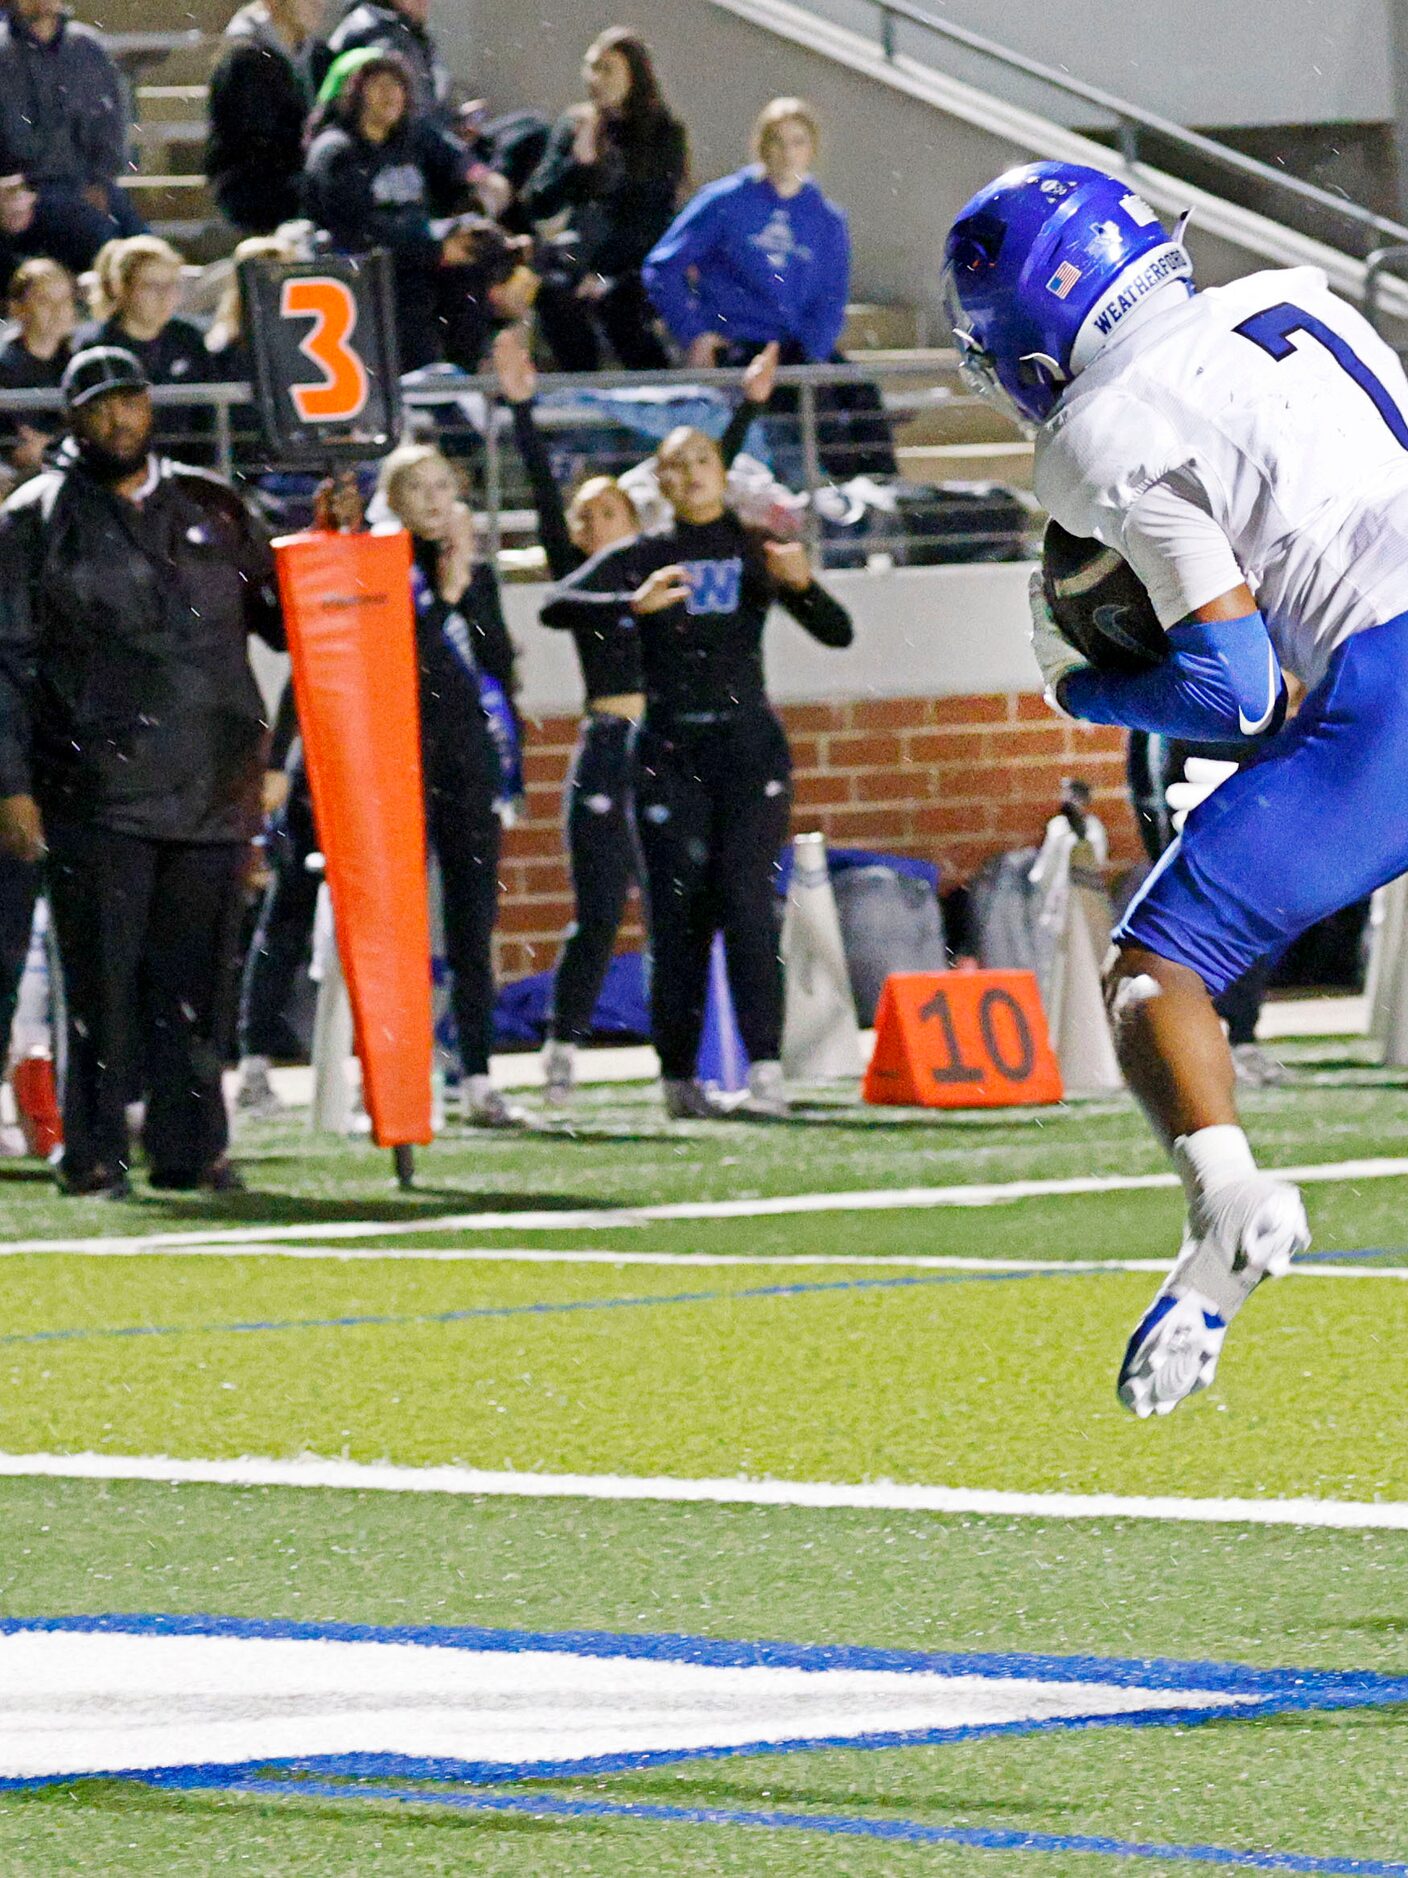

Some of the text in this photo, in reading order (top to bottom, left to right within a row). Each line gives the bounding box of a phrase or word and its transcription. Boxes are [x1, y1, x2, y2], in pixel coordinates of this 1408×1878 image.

[280, 276, 369, 423] 3
[682, 557, 743, 615] W
[918, 988, 1036, 1083] 10
